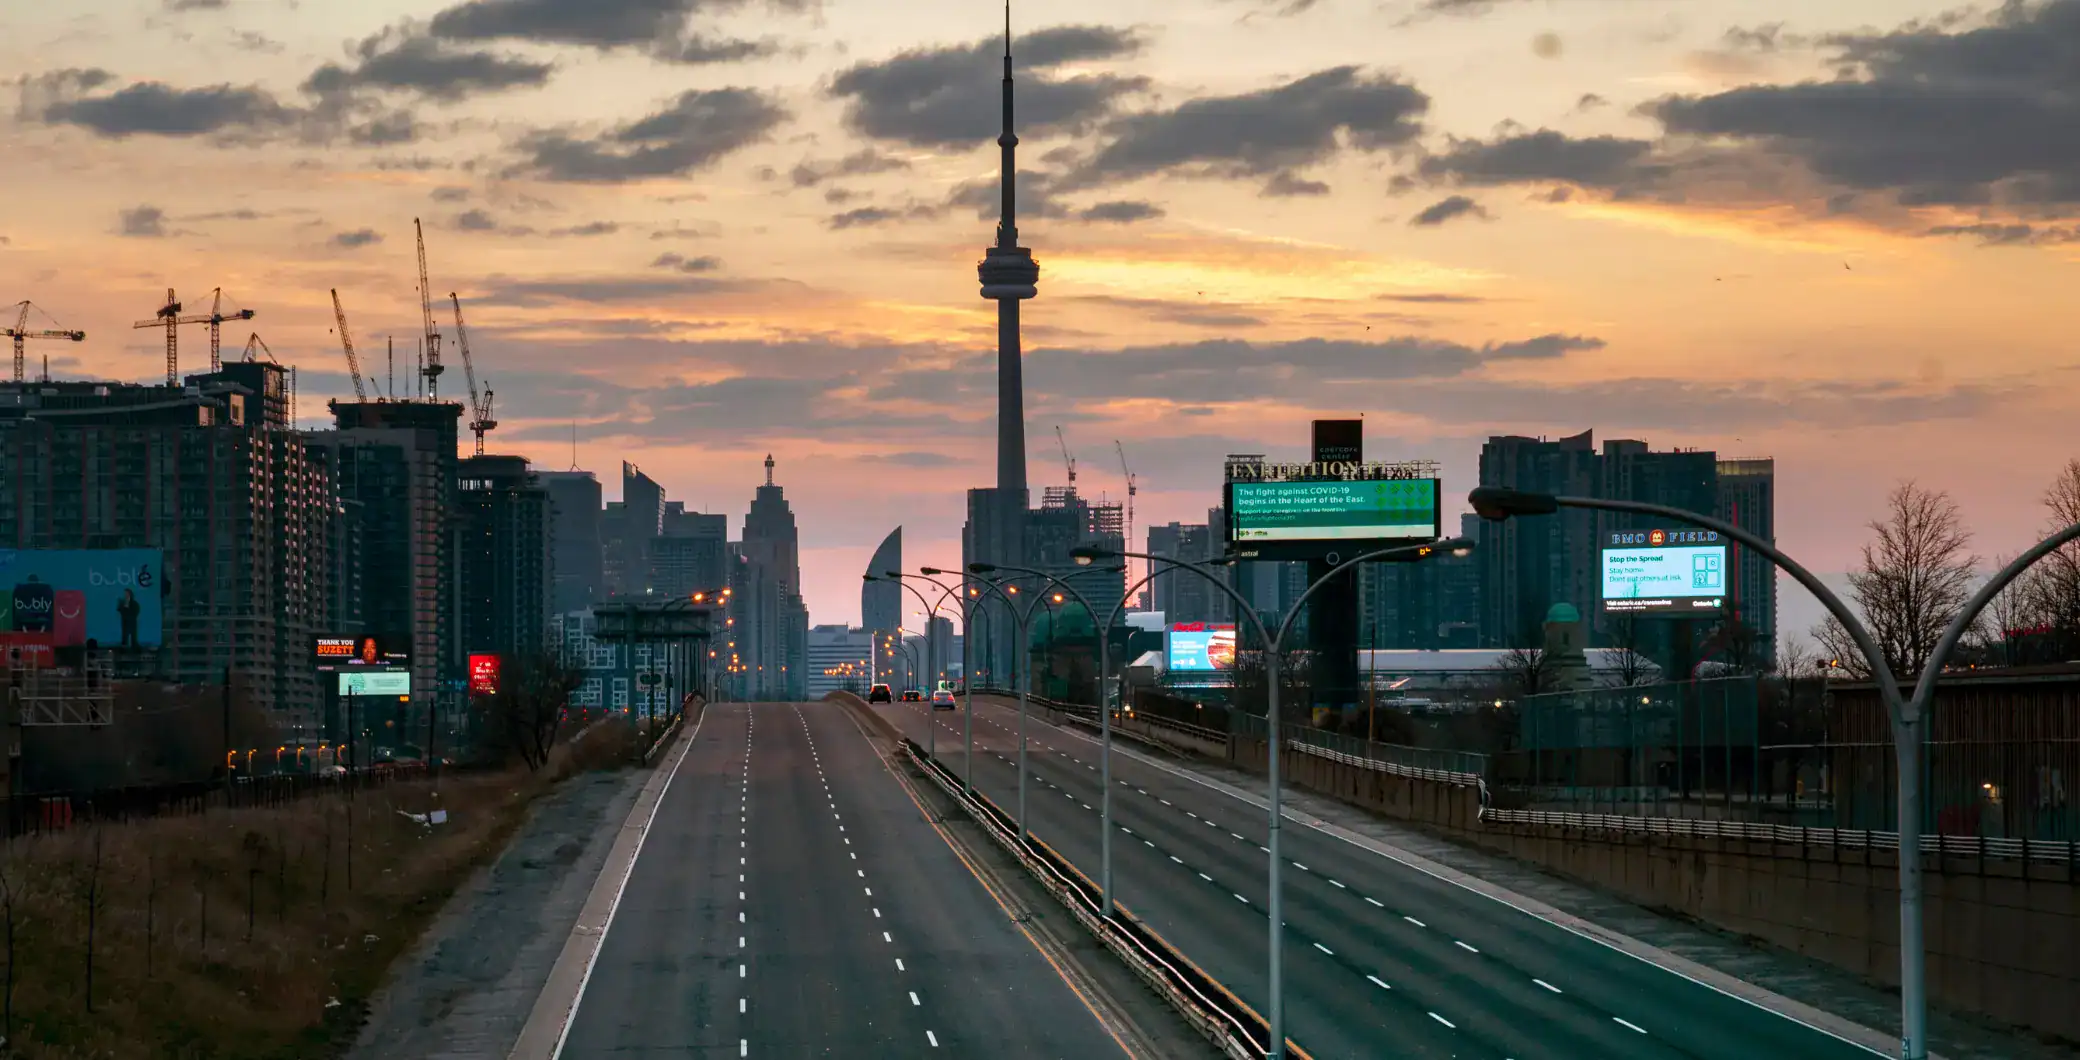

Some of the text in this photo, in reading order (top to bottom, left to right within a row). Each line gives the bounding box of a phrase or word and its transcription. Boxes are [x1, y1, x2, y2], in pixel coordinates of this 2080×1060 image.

[1238, 486, 1350, 497] The fight against COVID-19
[1238, 497, 1267, 506] begins
[1268, 497, 1277, 505] in
[1278, 496, 1292, 505] the
[1293, 496, 1317, 504] Heart
[1318, 496, 1328, 504] of
[1330, 496, 1344, 504] the
[1611, 531, 1718, 545] BMO FIELD
[1609, 555, 1664, 564] Stop the Spread
[1609, 567, 1624, 575] Stay
[14, 596, 52, 613] bubly
[317, 645, 355, 654] SUZETT
